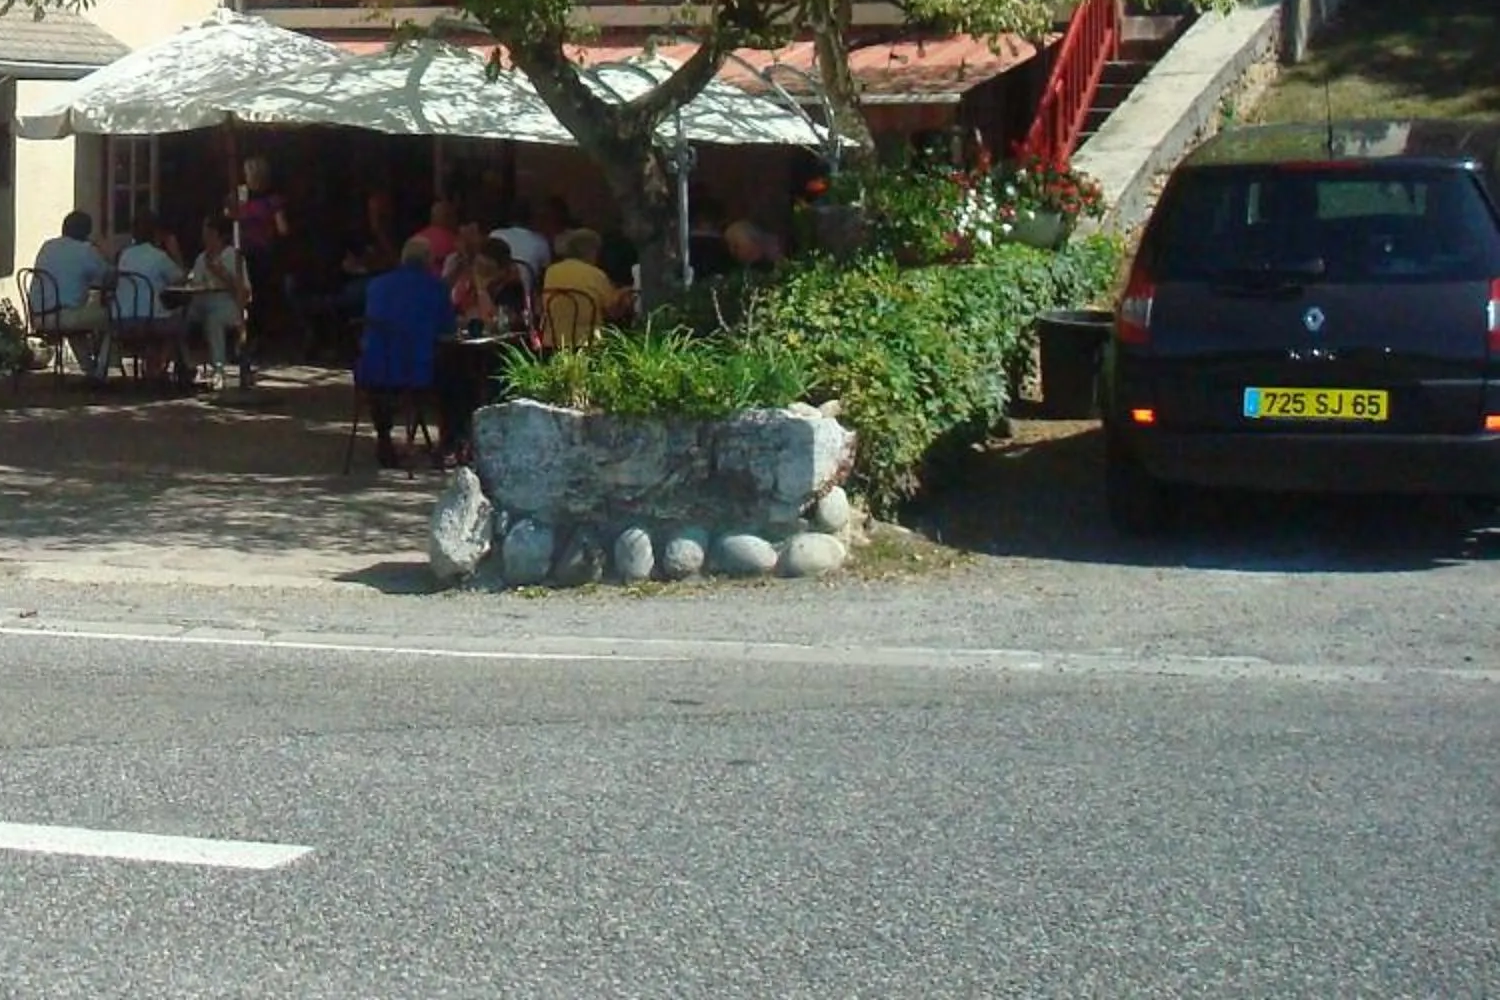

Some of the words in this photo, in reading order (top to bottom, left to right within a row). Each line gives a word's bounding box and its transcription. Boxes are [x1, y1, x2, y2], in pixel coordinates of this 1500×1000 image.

[1264, 392, 1305, 414] 725
[1315, 393, 1343, 415] SJ
[1352, 394, 1381, 416] 65
